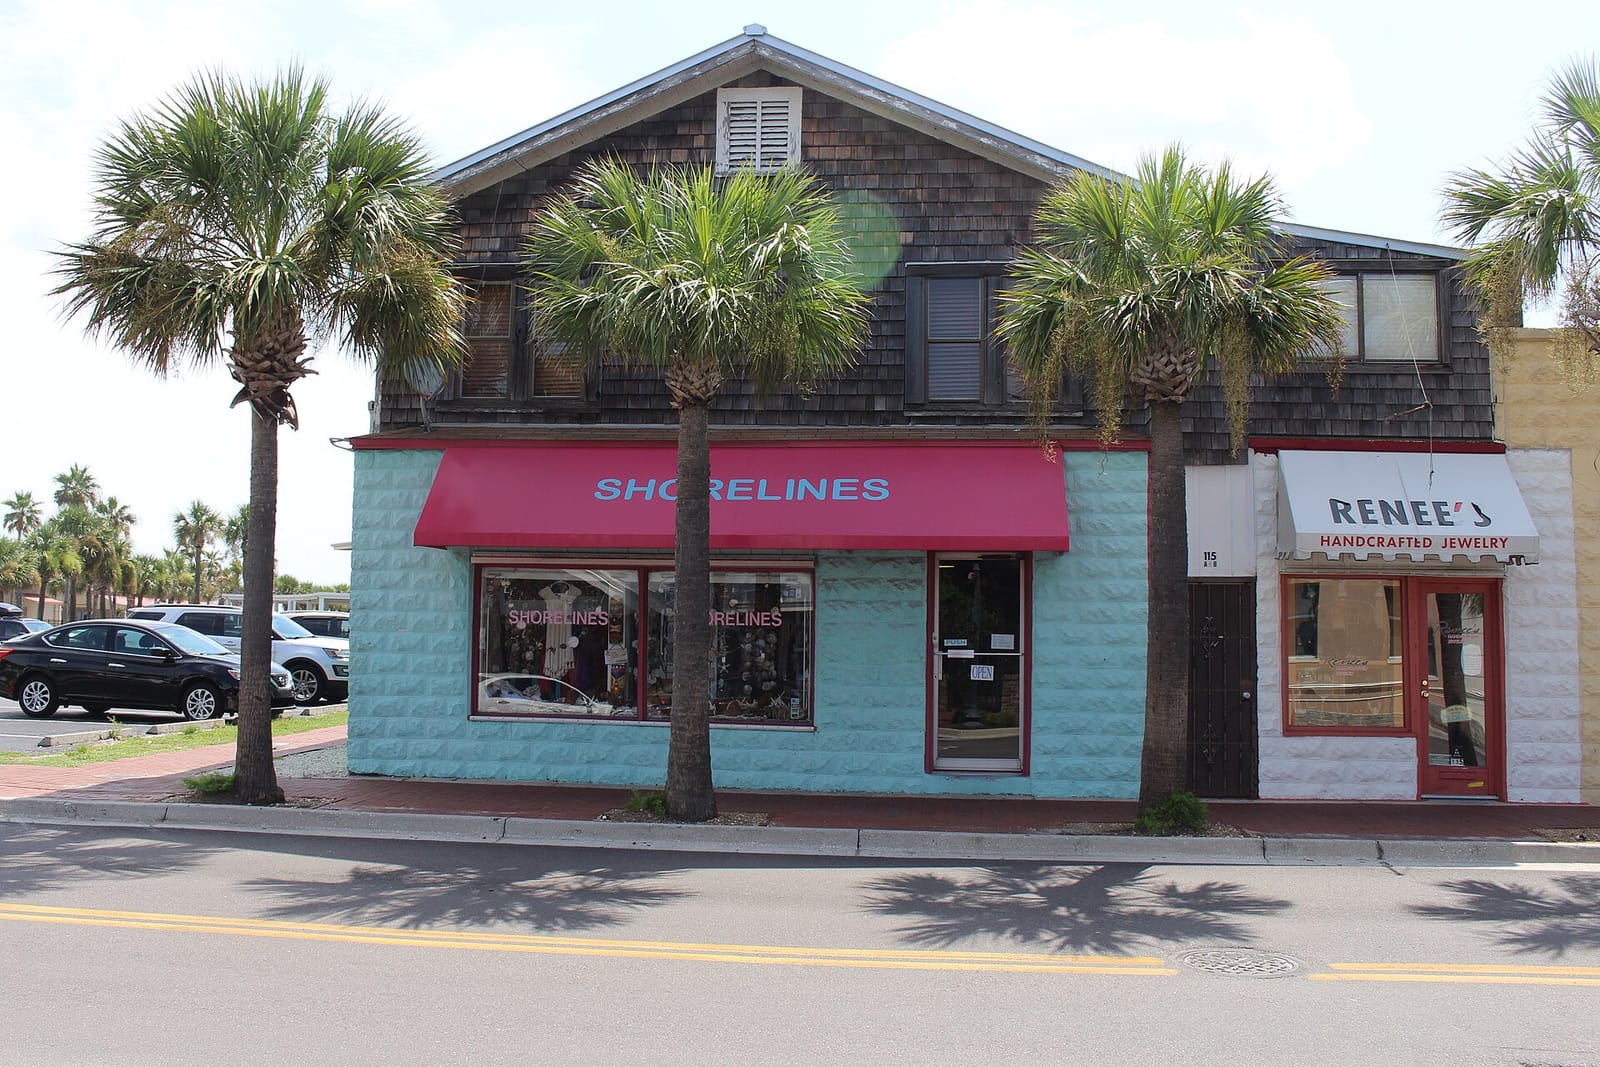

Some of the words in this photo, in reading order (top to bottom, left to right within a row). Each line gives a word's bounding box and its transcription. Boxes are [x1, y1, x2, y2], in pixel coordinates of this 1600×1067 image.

[1328, 498, 1492, 527] RENEE'S
[1320, 535, 1433, 548] HANDCRAFTED
[1441, 537, 1509, 549] JEWELRY
[1203, 551, 1217, 560] 115
[509, 609, 608, 625] SHORELINES
[708, 611, 782, 627] RELINES
[972, 666, 993, 679] OPEN
